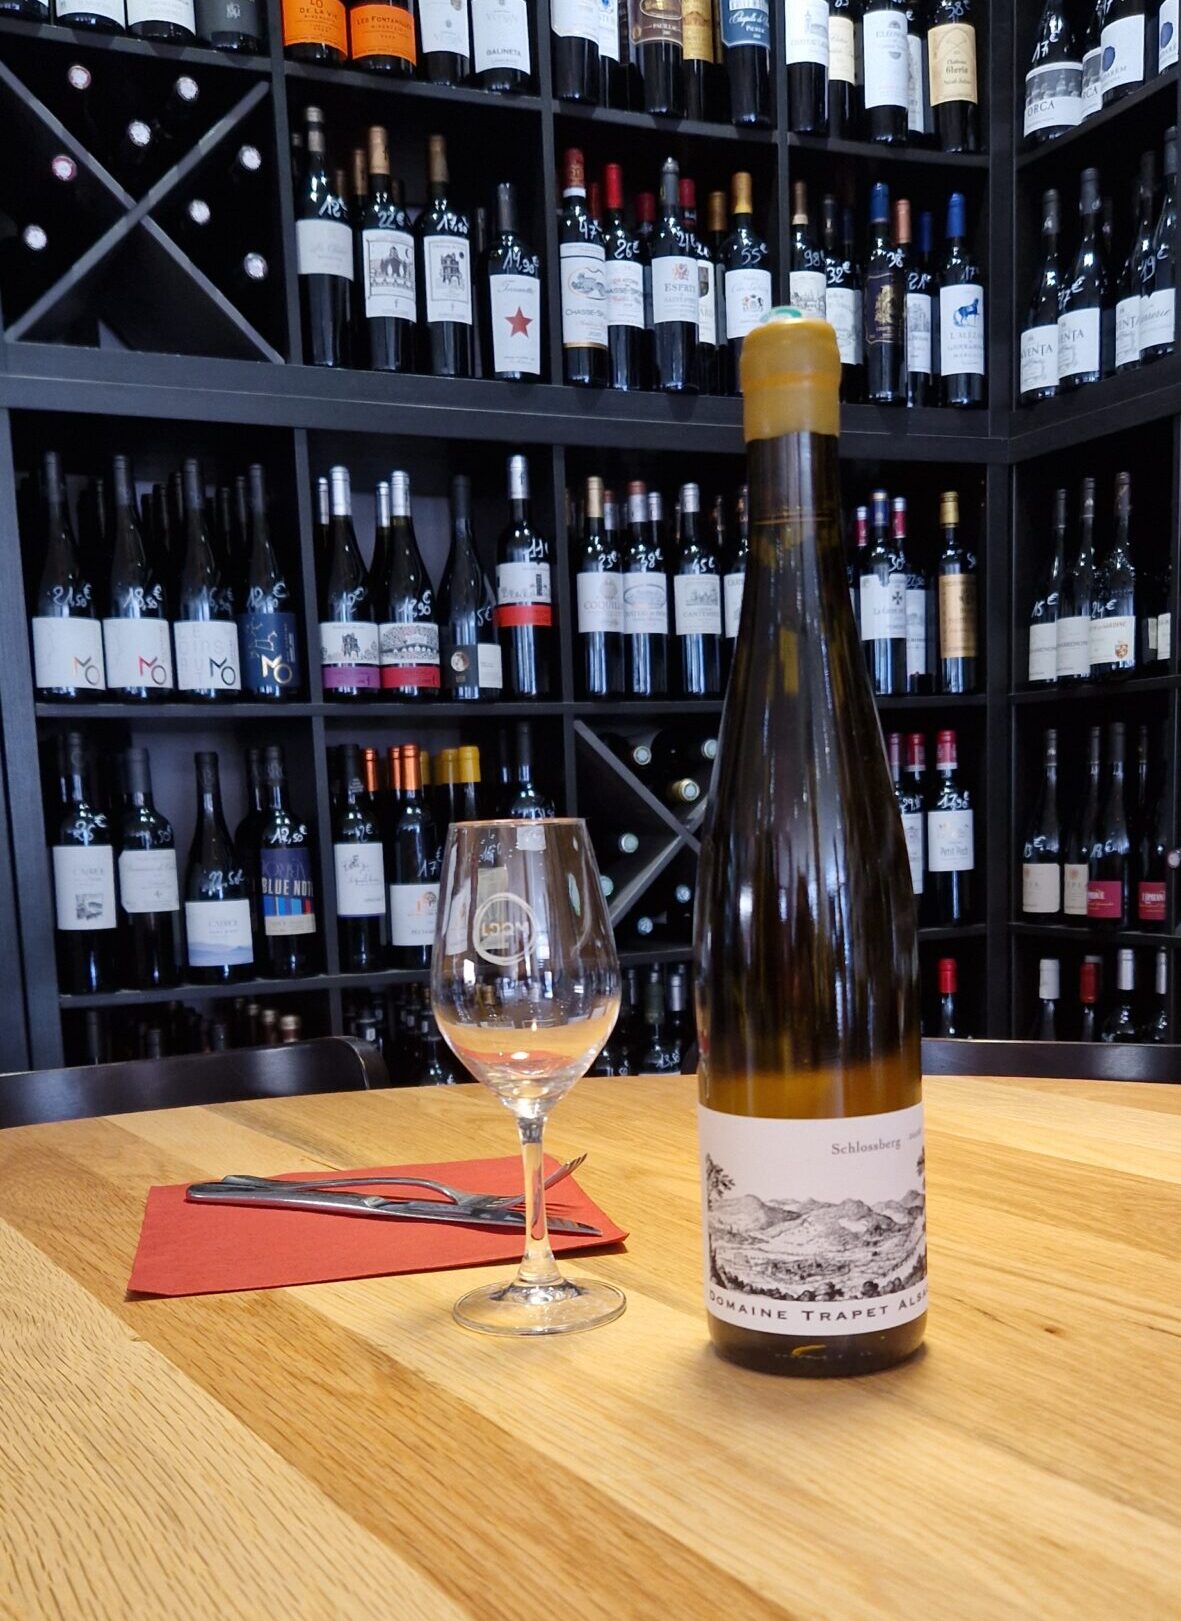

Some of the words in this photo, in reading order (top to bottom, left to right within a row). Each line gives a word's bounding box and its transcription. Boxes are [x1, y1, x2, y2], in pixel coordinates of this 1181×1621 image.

[262, 877, 289, 895] BLUE
[832, 1138, 900, 1155] Schlossberg
[709, 1289, 788, 1320] DOMAINE
[802, 1304, 888, 1322] TRAPET
